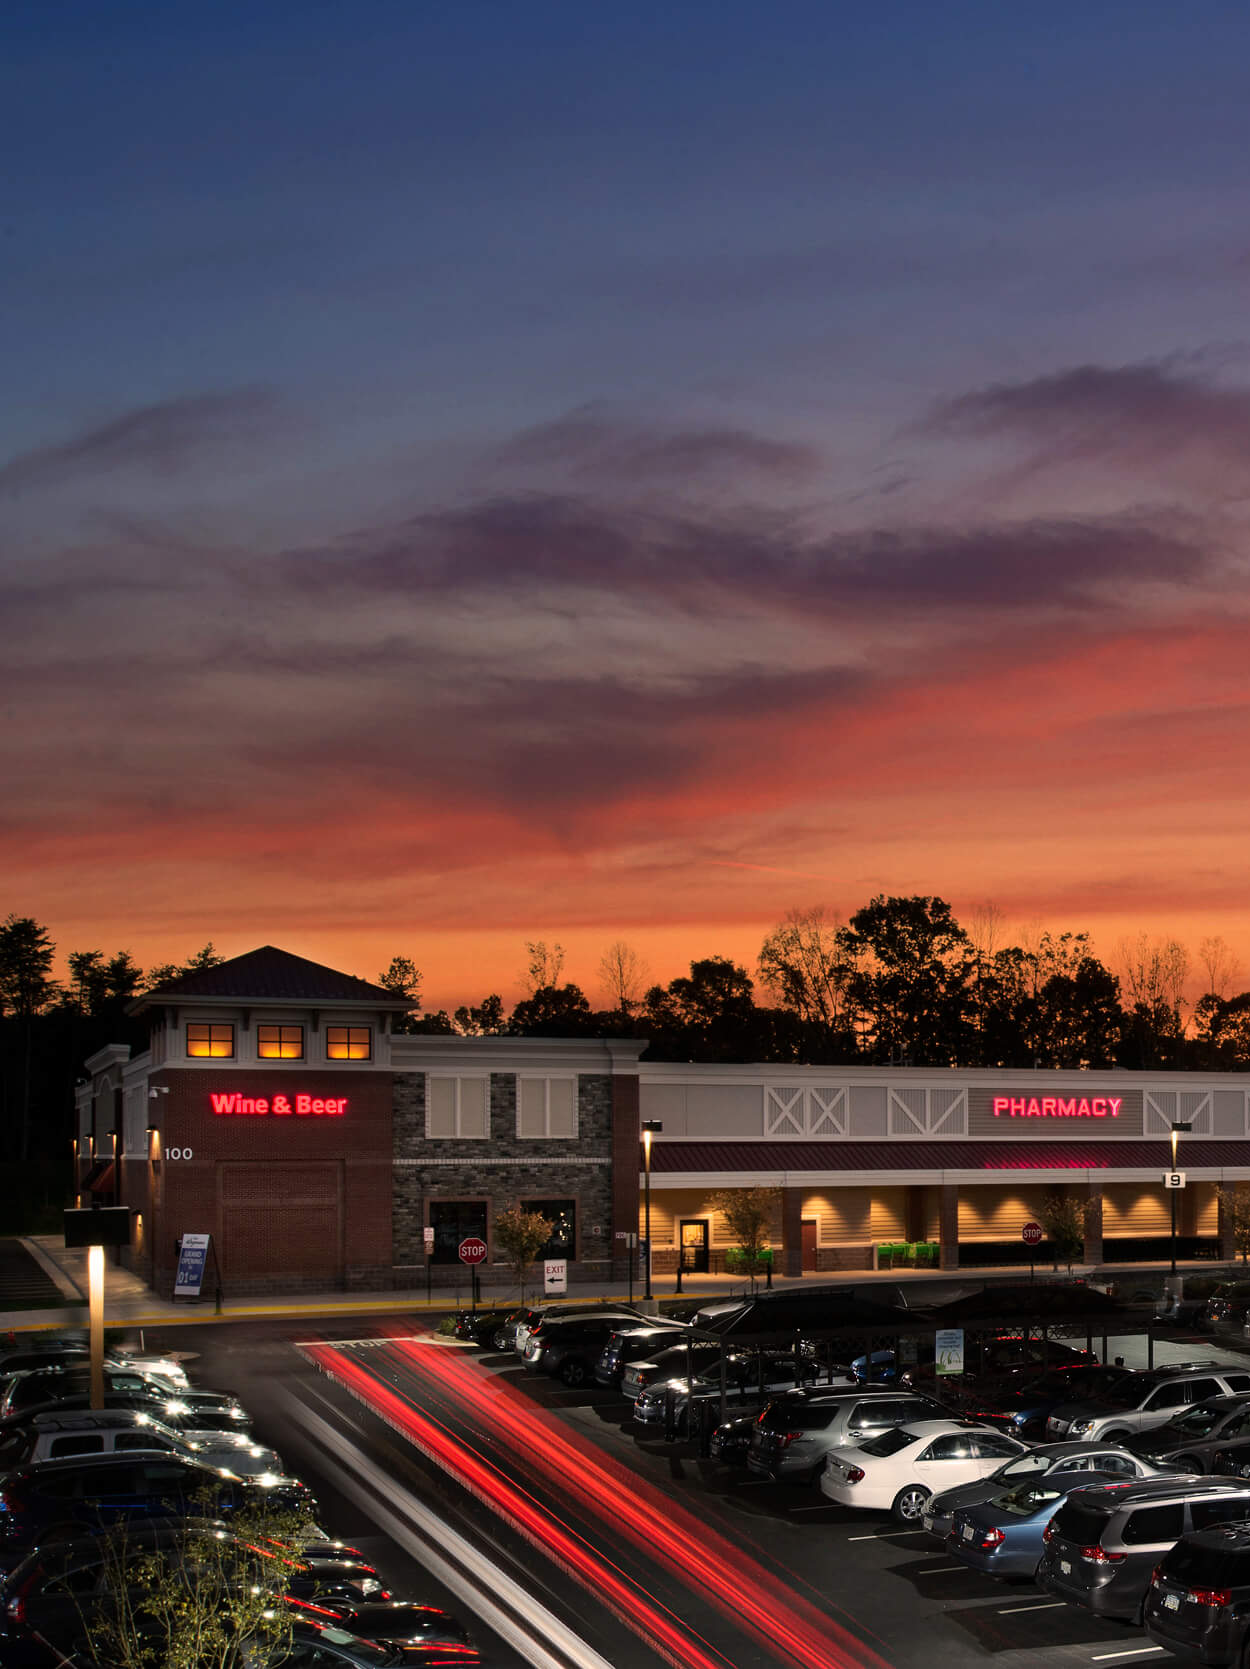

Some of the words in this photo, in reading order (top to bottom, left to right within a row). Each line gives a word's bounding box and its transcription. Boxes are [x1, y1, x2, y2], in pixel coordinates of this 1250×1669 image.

[210, 1092, 269, 1114] Wine
[272, 1094, 292, 1114] &
[296, 1094, 347, 1114] Beer
[993, 1097, 1122, 1117] PHARMACY
[164, 1148, 193, 1160] 100
[1170, 1174, 1181, 1186] 9
[1023, 1229, 1041, 1239] STOP
[461, 1246, 486, 1257] STOP
[546, 1266, 566, 1274] EXIT
